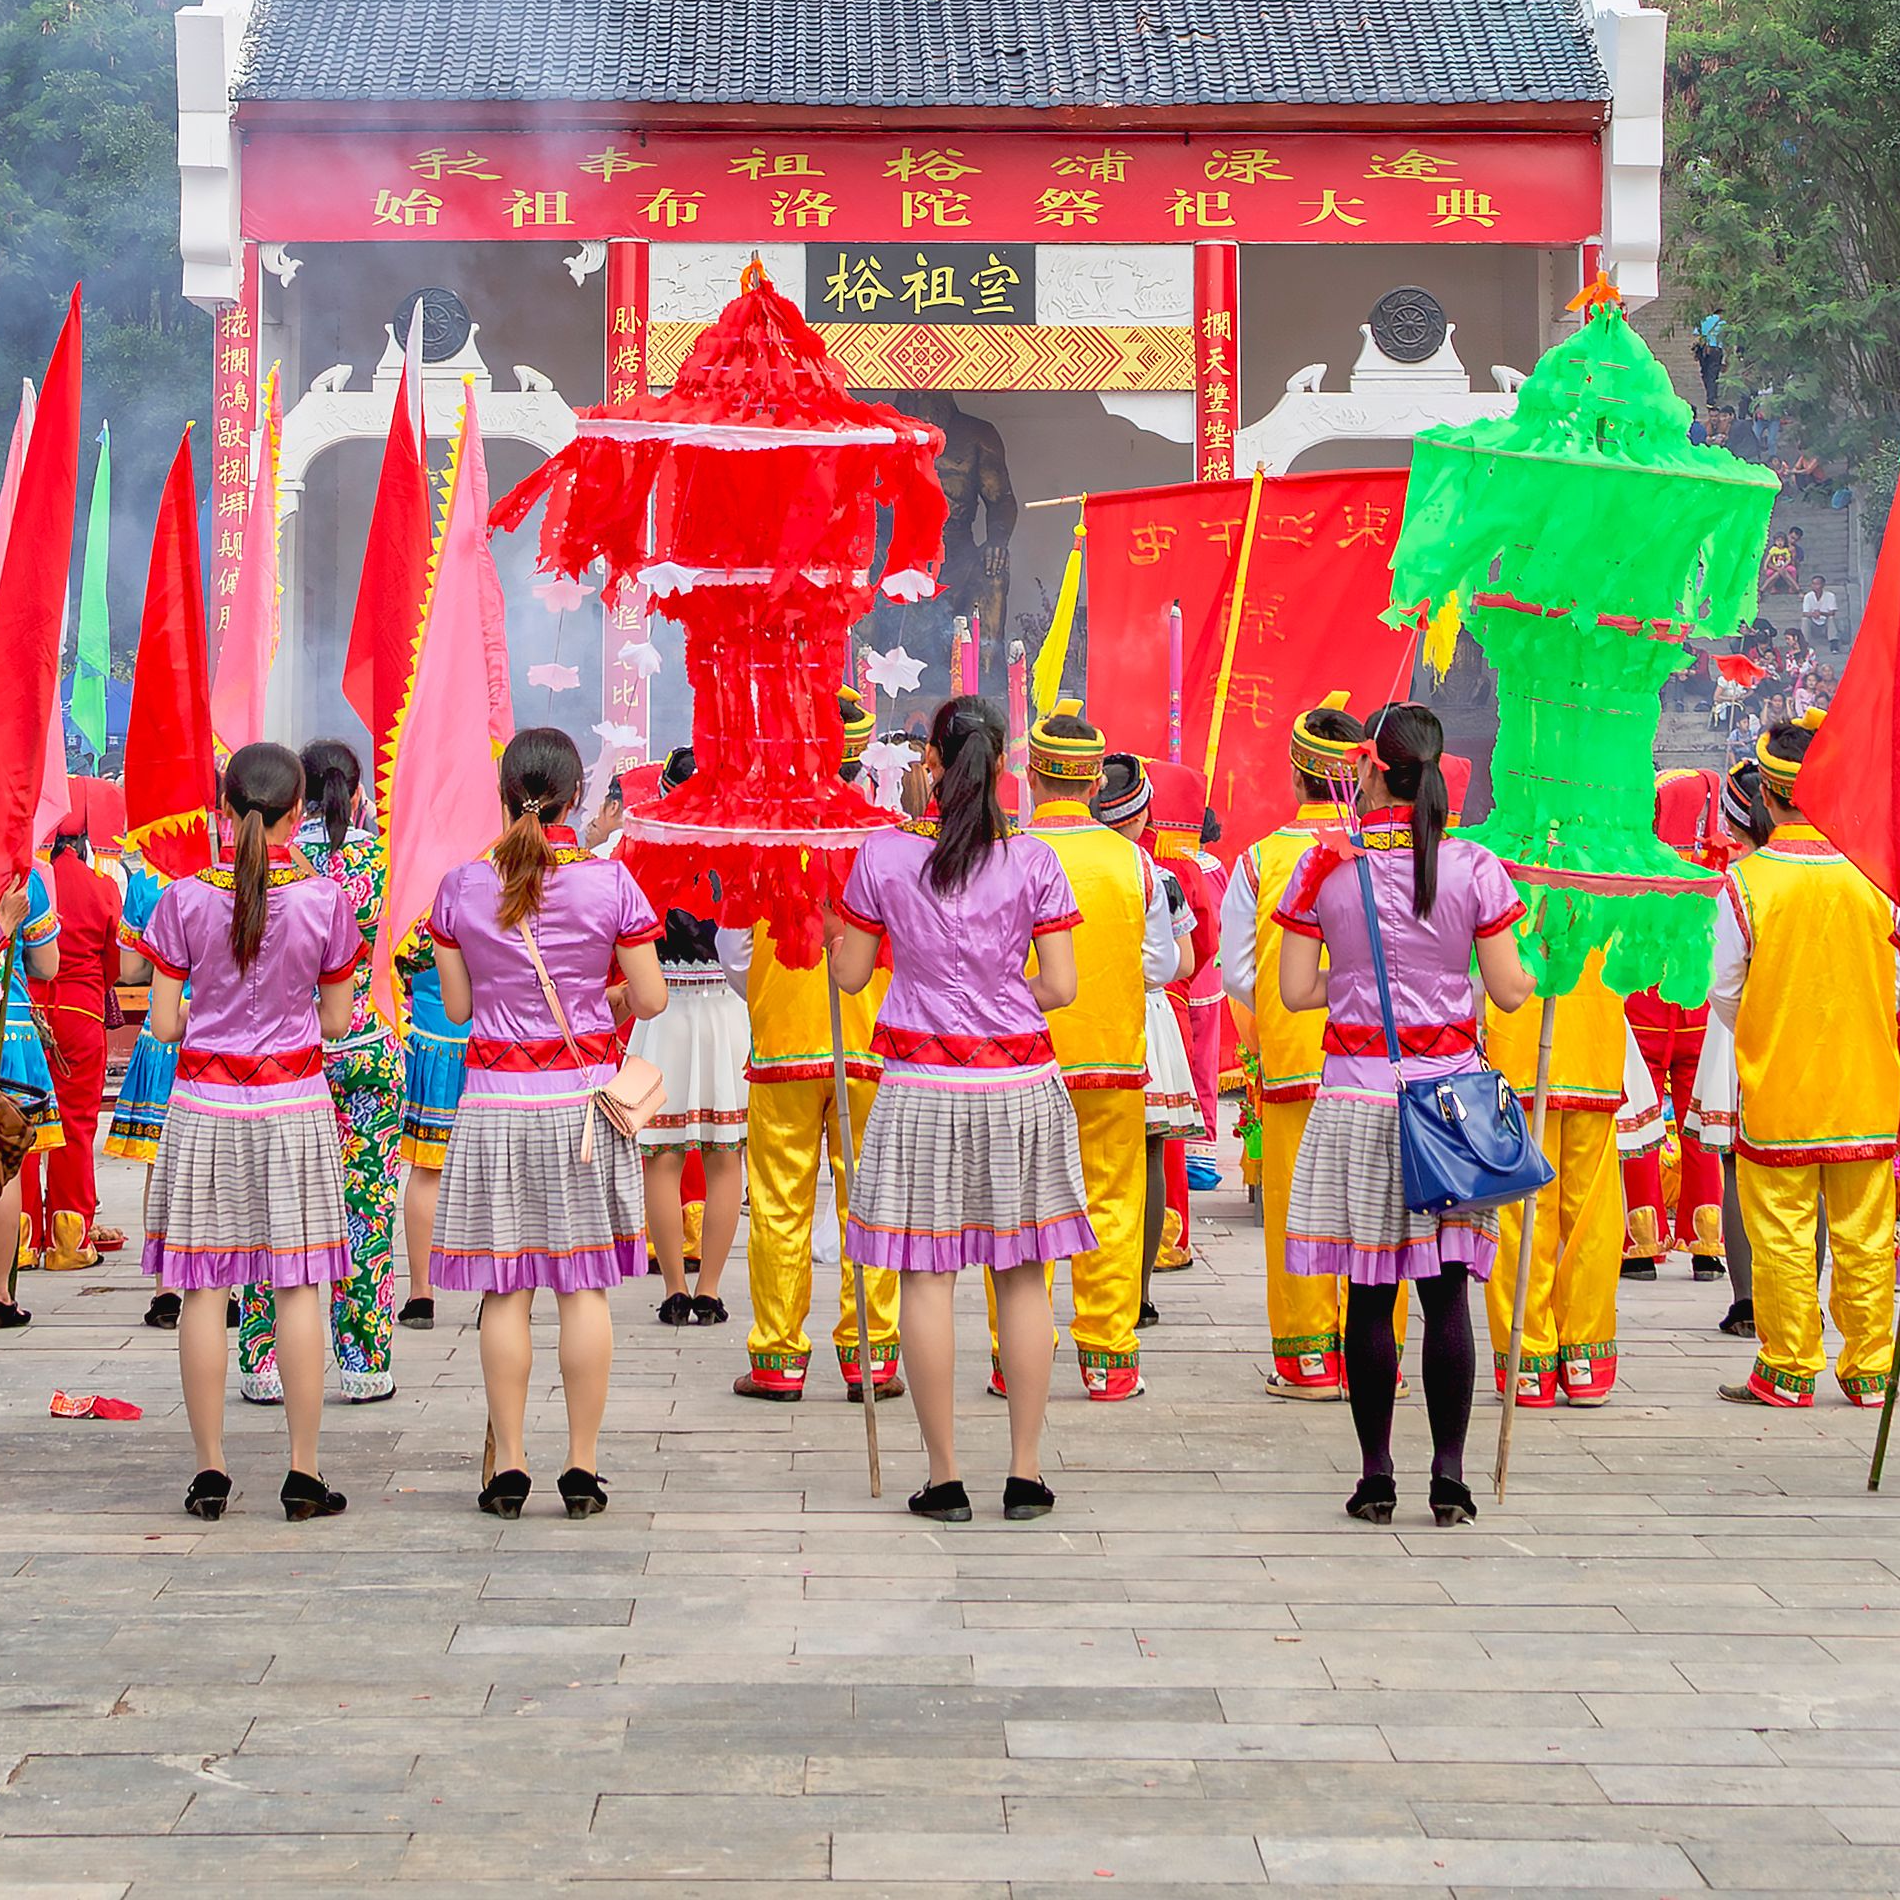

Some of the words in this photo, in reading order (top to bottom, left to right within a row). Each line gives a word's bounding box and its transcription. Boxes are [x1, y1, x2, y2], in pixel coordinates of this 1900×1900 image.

[370, 187, 1501, 228] 始祖布洛陀祭祀大典
